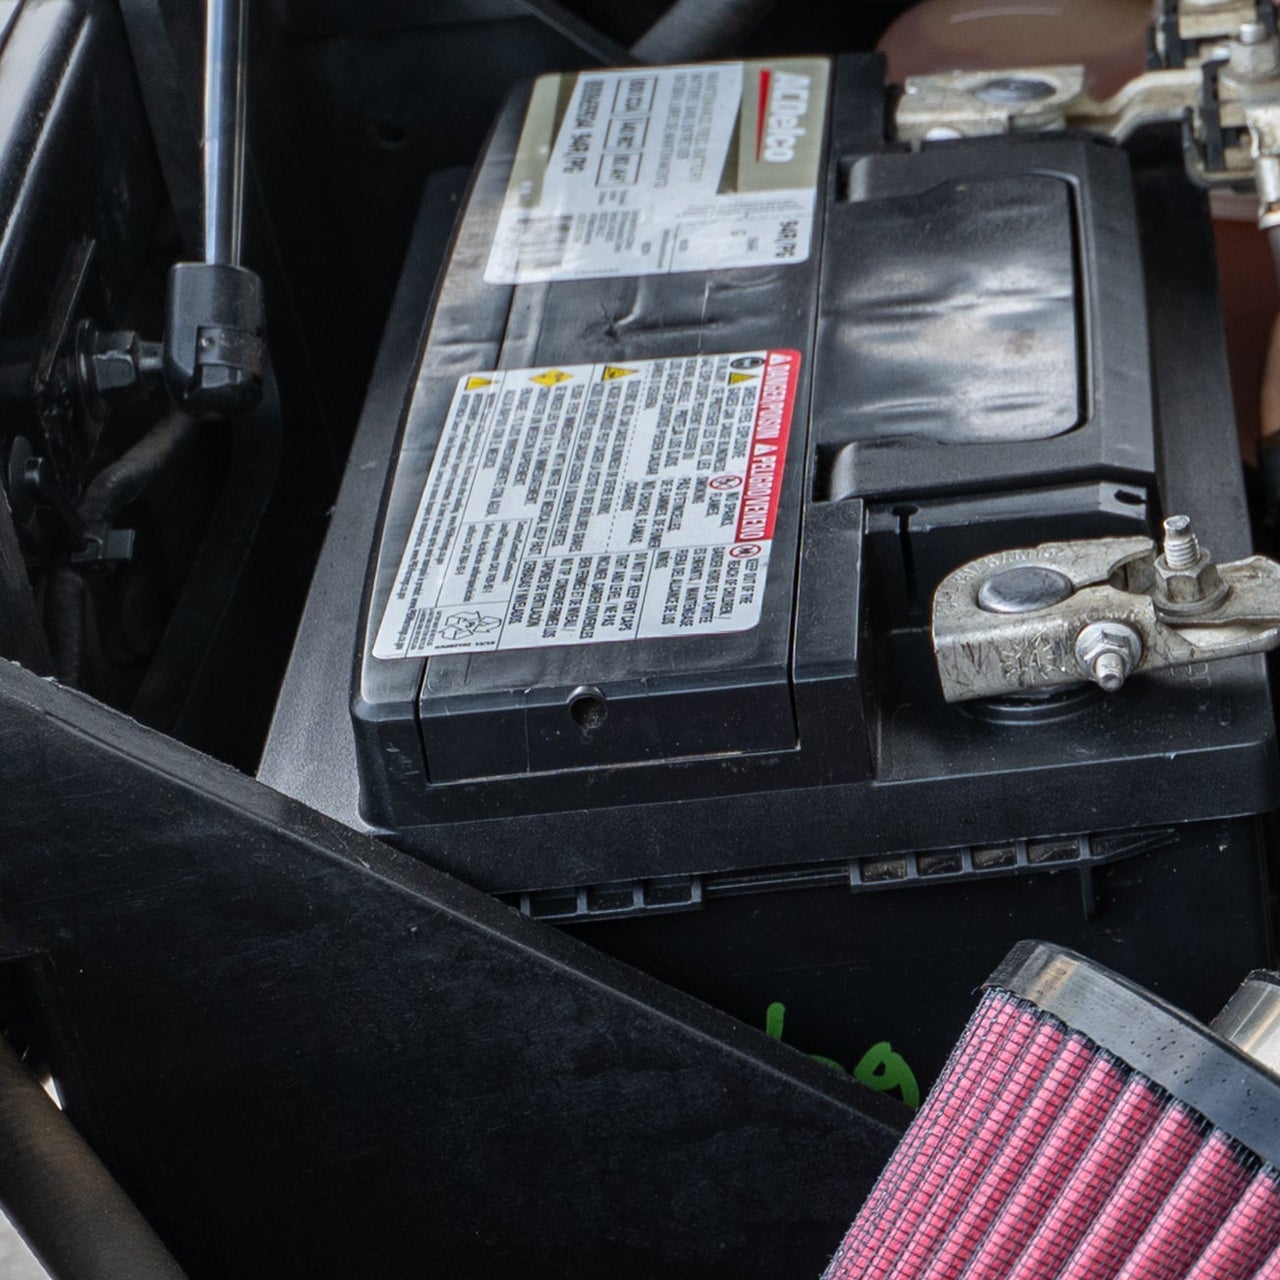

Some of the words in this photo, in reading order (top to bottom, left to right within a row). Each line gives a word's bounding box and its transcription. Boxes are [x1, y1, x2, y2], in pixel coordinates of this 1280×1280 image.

[761, 69, 812, 163] ACDelco
[754, 364, 791, 439] DANGER/POISON
[738, 455, 776, 539] PELIGRO/VENENO
[673, 549, 688, 566] FUERA
[744, 558, 758, 571] KEEP
[670, 566, 685, 577] DEL
[742, 573, 756, 584] OUT
[665, 578, 683, 604] ALCANCE
[739, 593, 752, 604] THE
[661, 613, 676, 624] LOS
